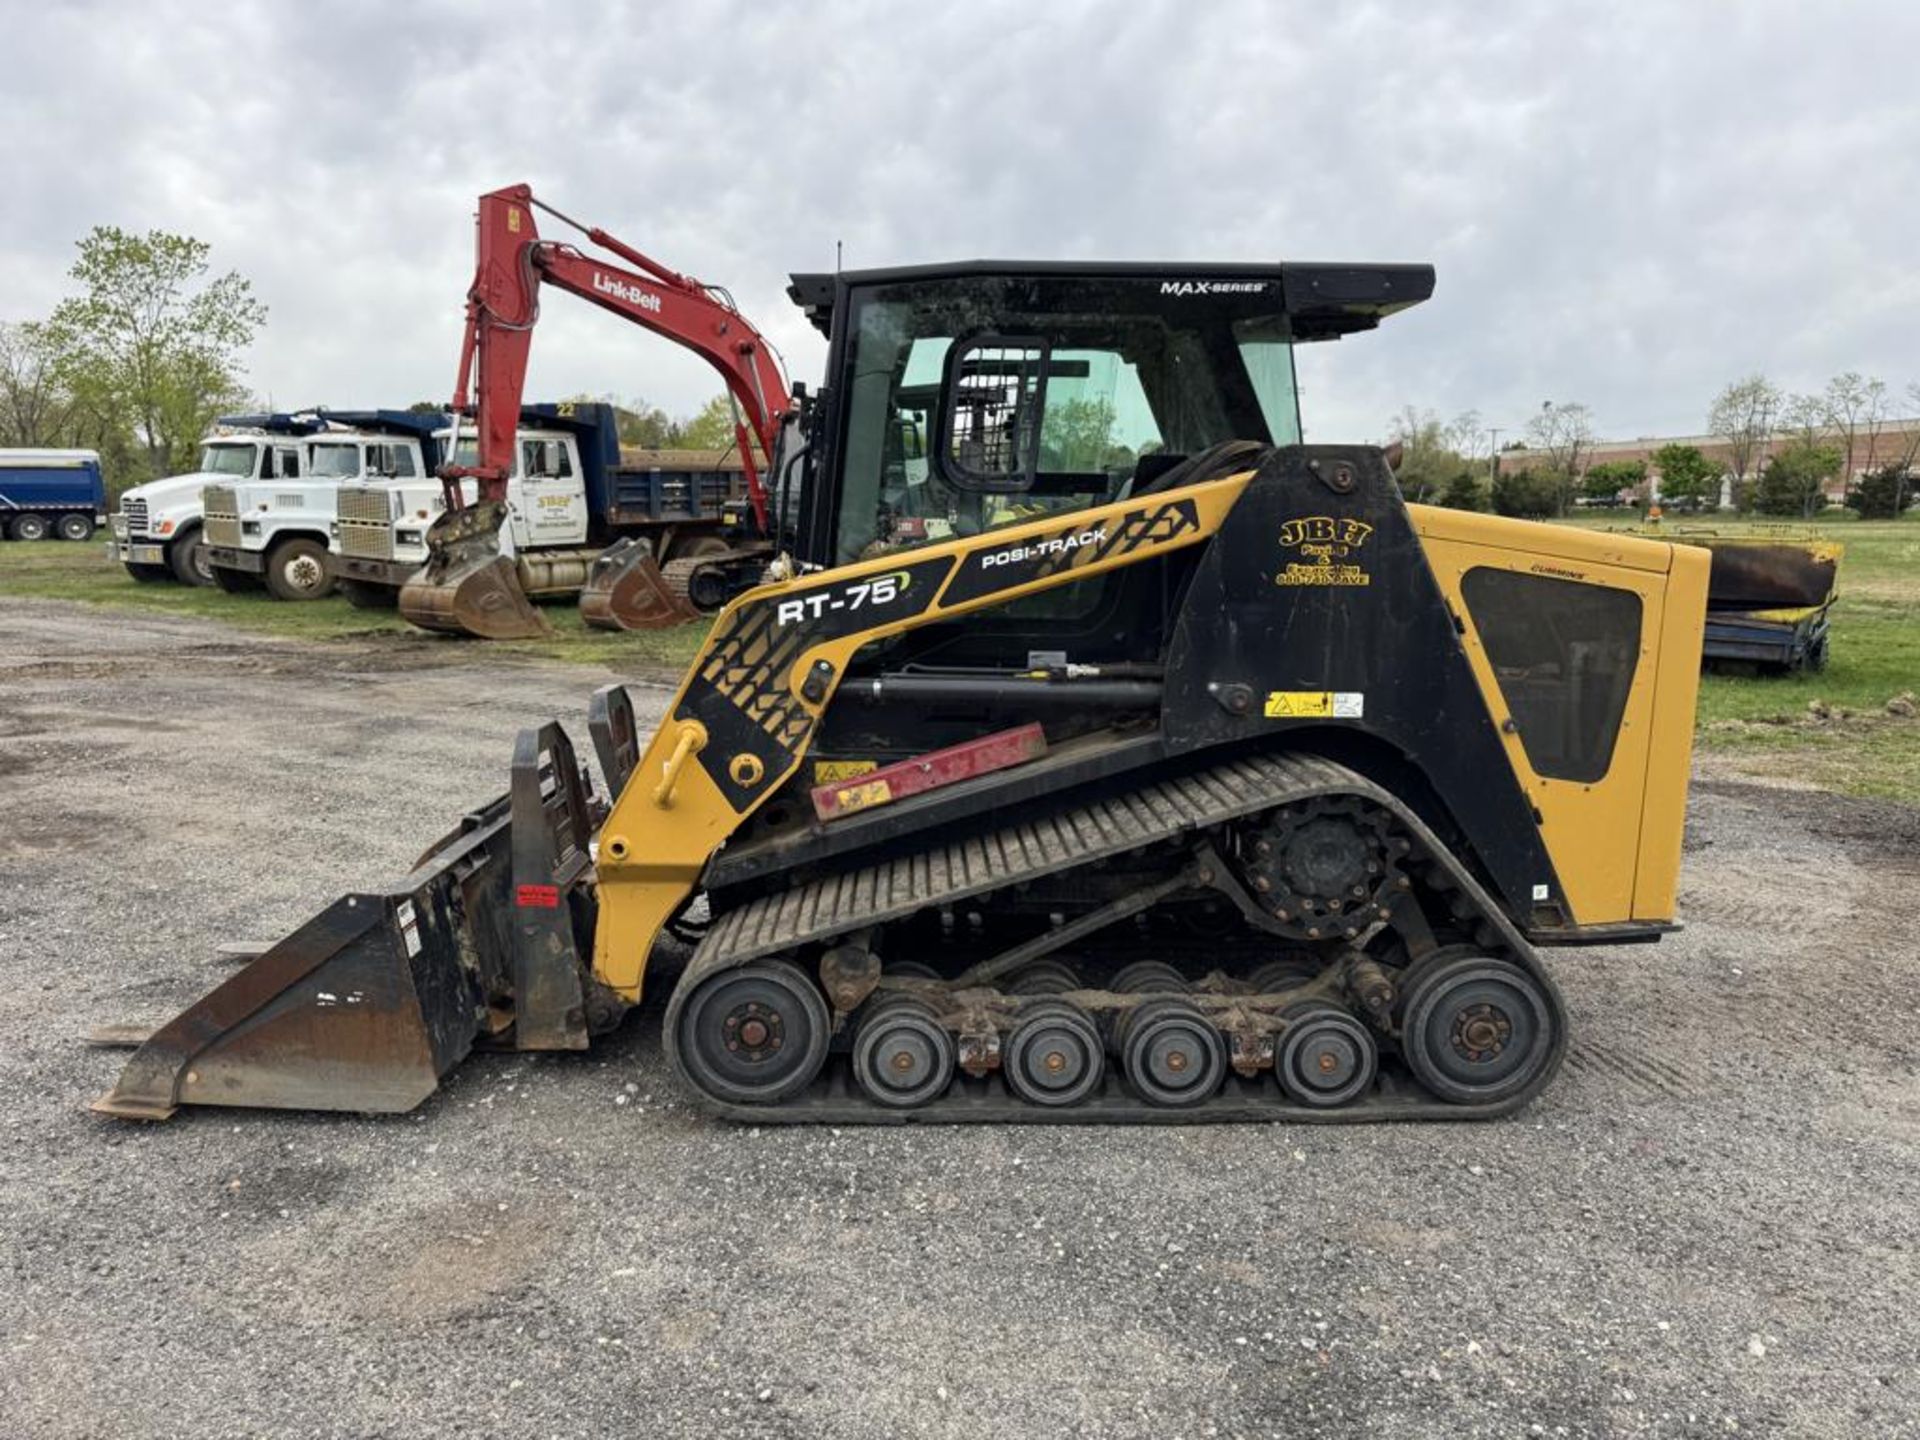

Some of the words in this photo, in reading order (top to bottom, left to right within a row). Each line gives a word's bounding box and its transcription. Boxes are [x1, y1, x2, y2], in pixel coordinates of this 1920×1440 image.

[593, 272, 661, 313] Link-Belt
[1160, 282, 1264, 297] MAX-SERIES
[557, 403, 575, 417] 22
[982, 528, 1106, 570] POSI-TRACK
[778, 578, 897, 626] RT-75
